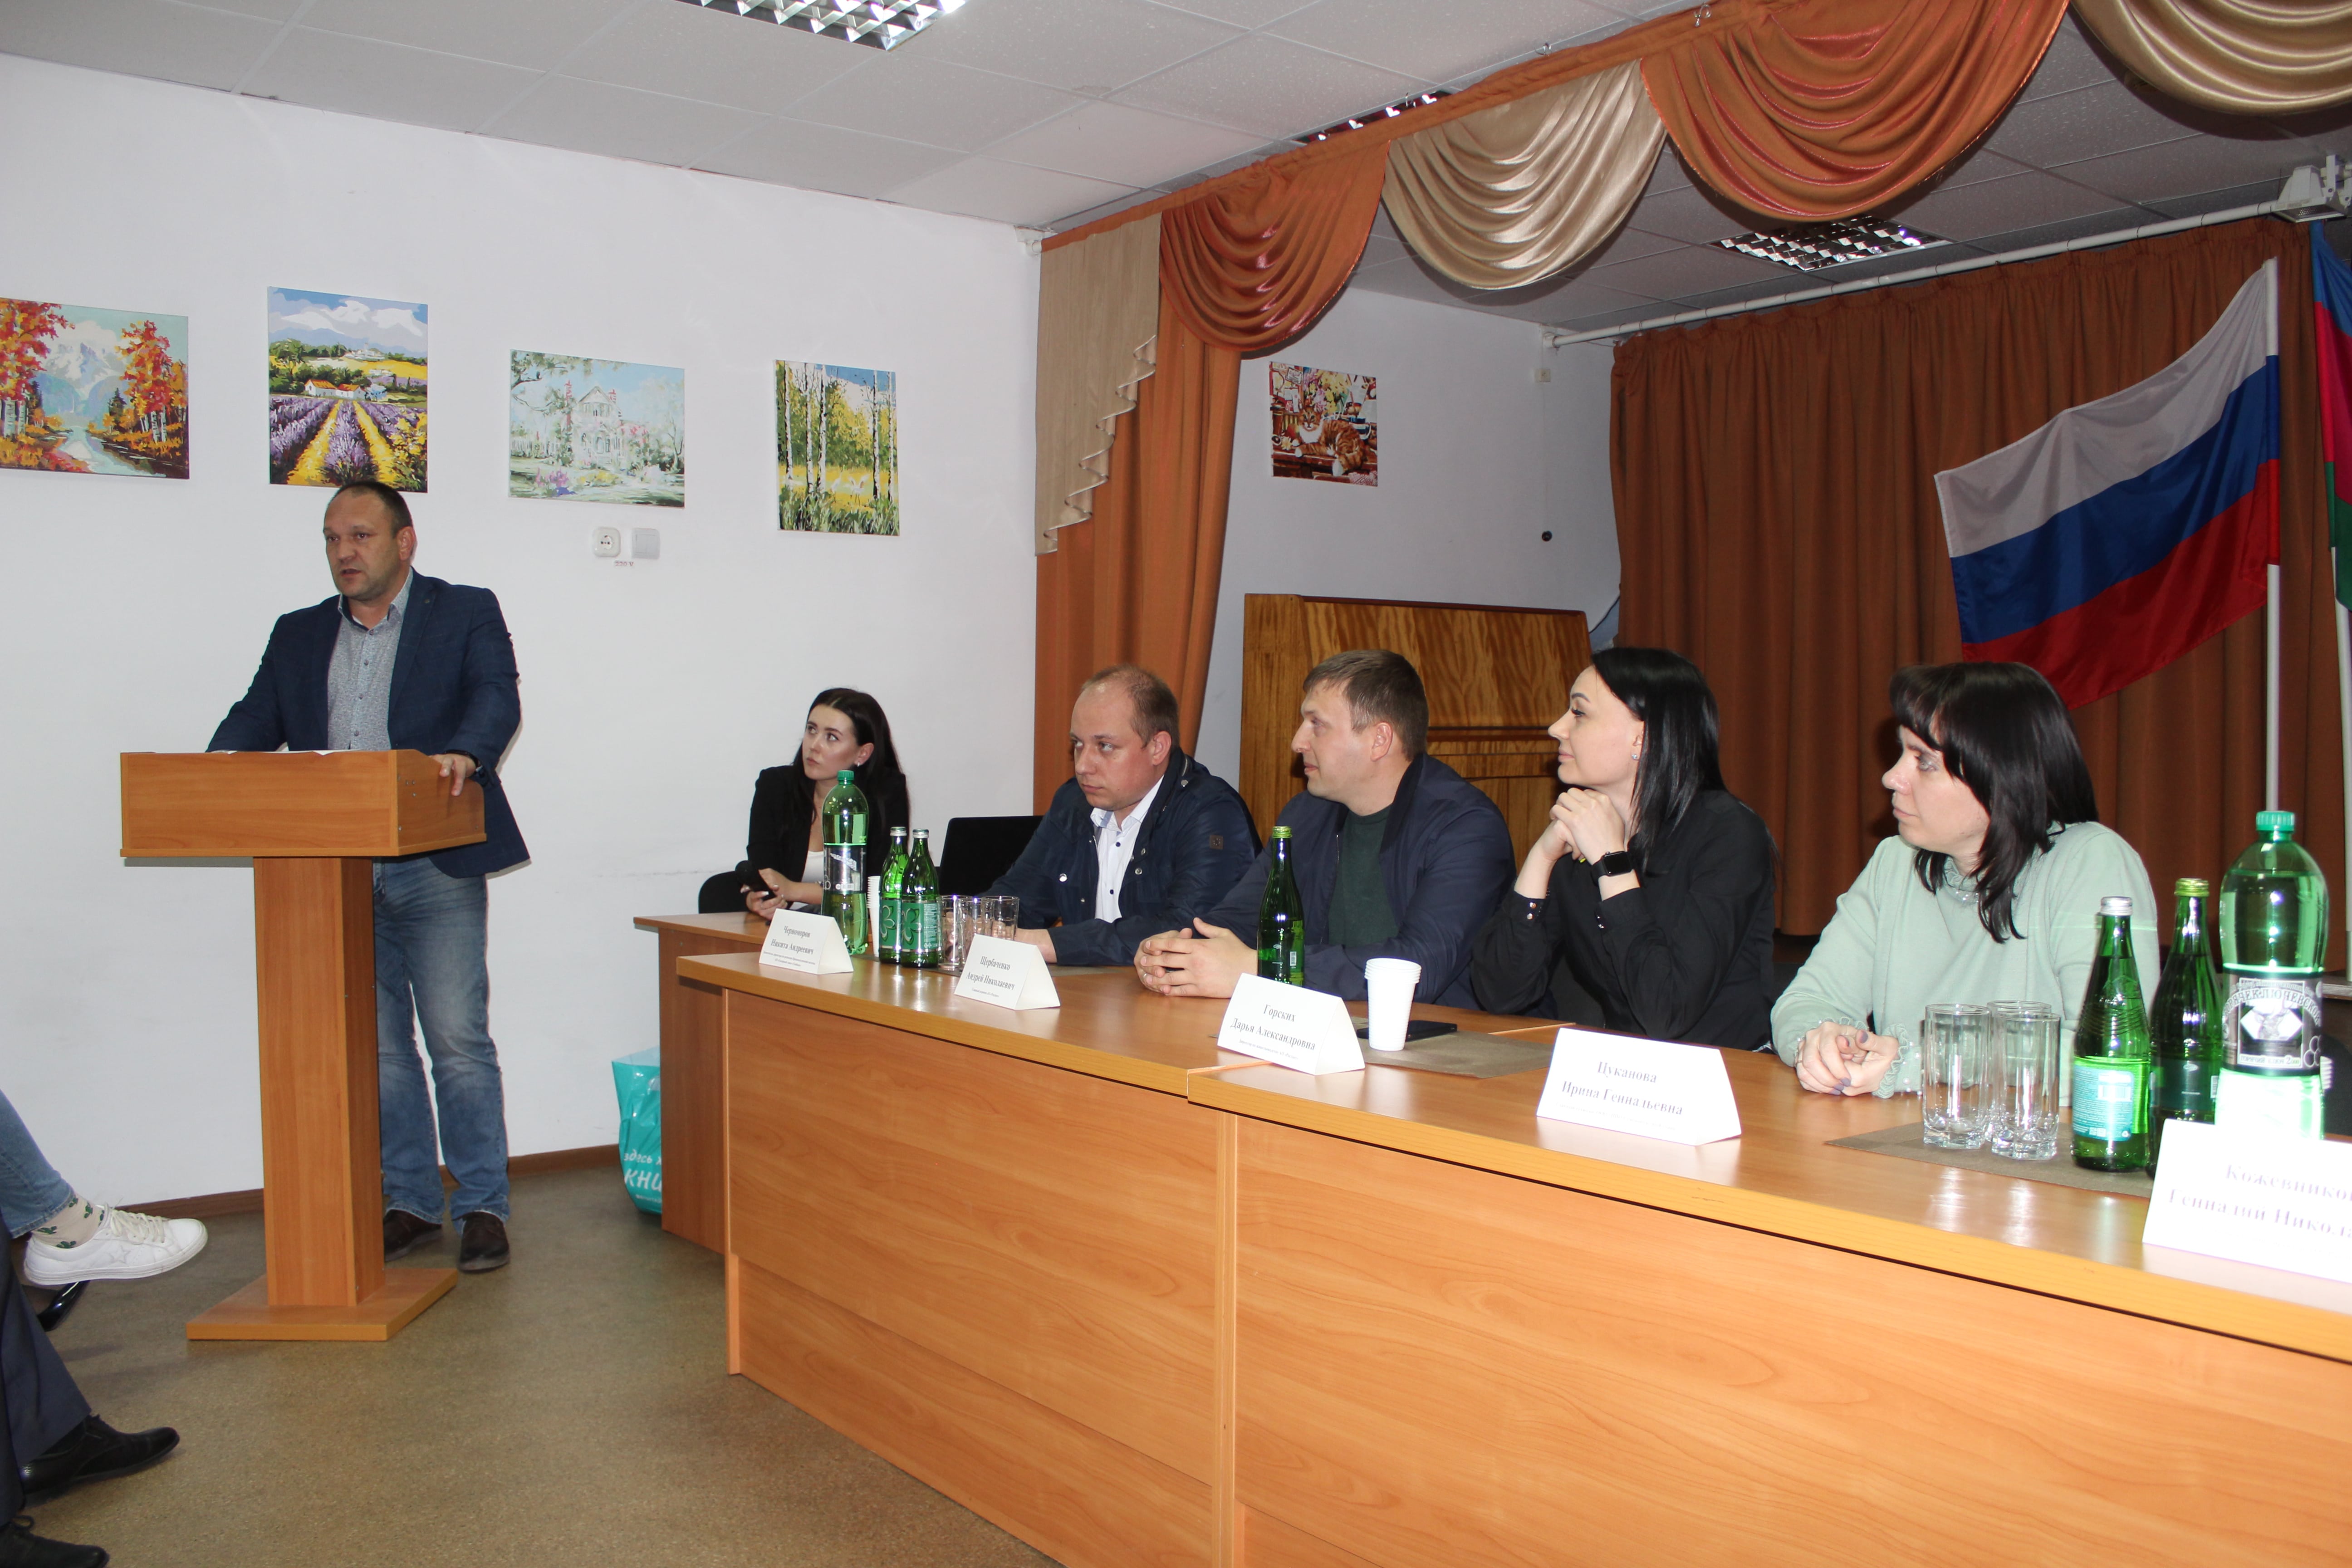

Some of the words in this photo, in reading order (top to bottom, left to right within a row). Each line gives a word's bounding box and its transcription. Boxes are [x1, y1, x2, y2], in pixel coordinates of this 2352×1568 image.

[771, 938, 789, 950] Никита
[789, 943, 814, 955] Андреевич
[980, 956, 1011, 970] Щербаченко
[966, 971, 985, 983] Андрей
[984, 975, 1015, 990] Николаевич
[1263, 1004, 1296, 1023] Горских
[1230, 1018, 1254, 1034] Дарья
[1255, 1025, 1315, 1051] Александровна
[1597, 1061, 1657, 1084] Цуканова
[1561, 1080, 1599, 1100] Ирина
[1603, 1088, 1683, 1116] Геннадьевна
[623, 1149, 653, 1164] здесь
[2225, 1164, 2352, 1202] Кожевнико
[2169, 1188, 2266, 1221] Геннадий
